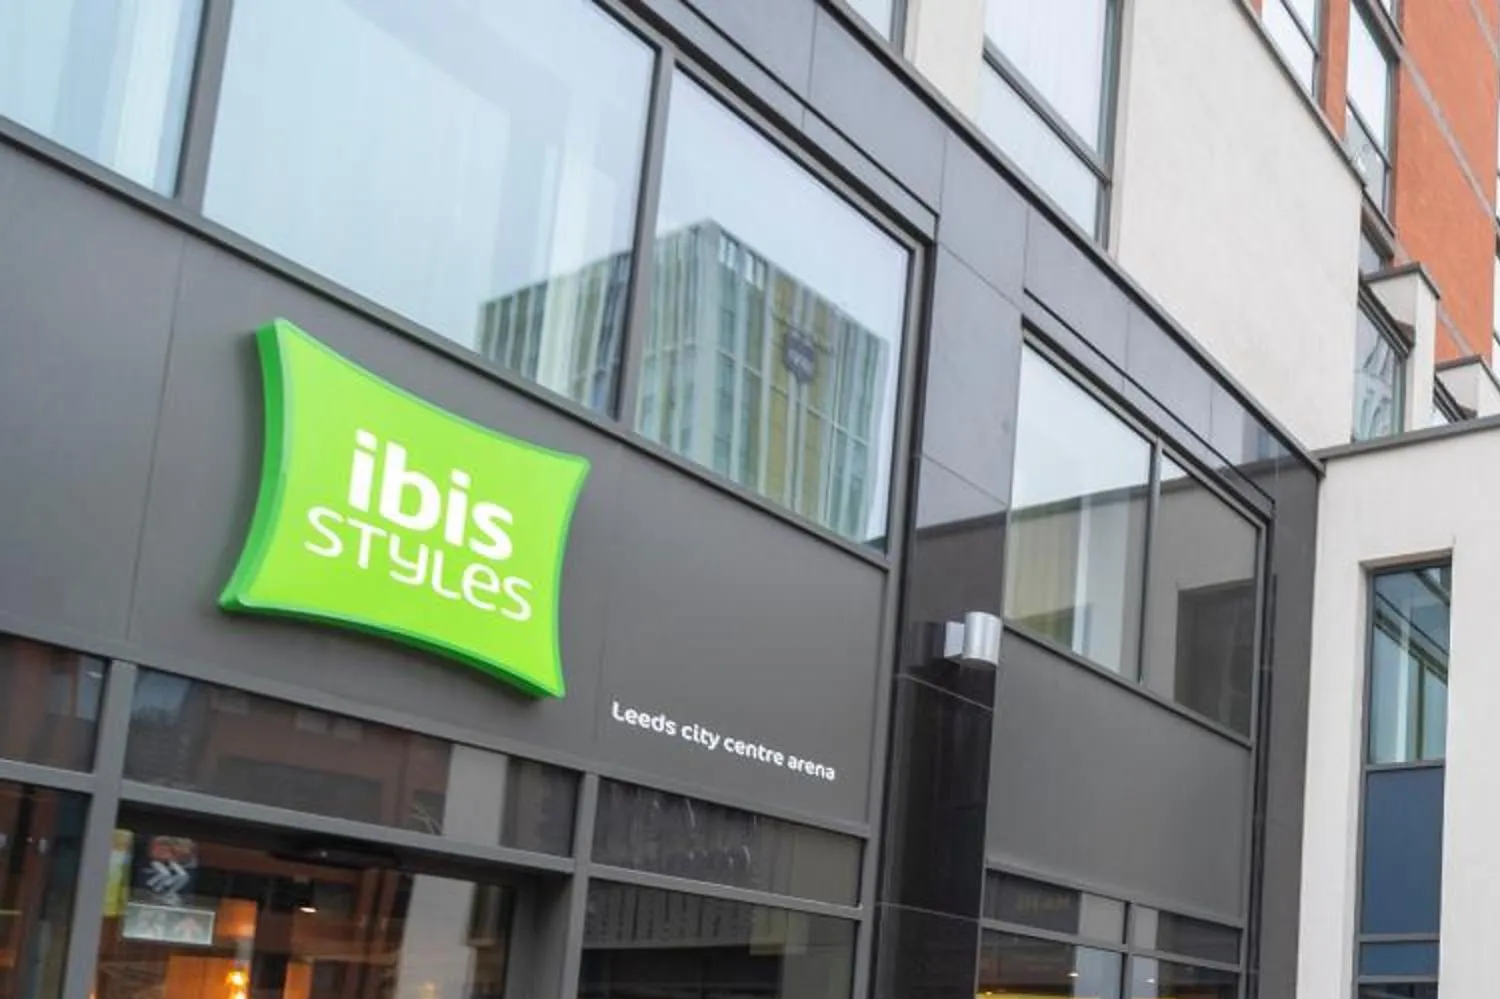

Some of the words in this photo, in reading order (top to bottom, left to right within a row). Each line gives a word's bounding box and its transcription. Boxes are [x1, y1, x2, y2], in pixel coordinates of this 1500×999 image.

[348, 428, 513, 561] ibis
[611, 700, 677, 736] Leeds
[681, 723, 720, 750] city
[723, 737, 784, 766] centre
[787, 755, 836, 780] arena
